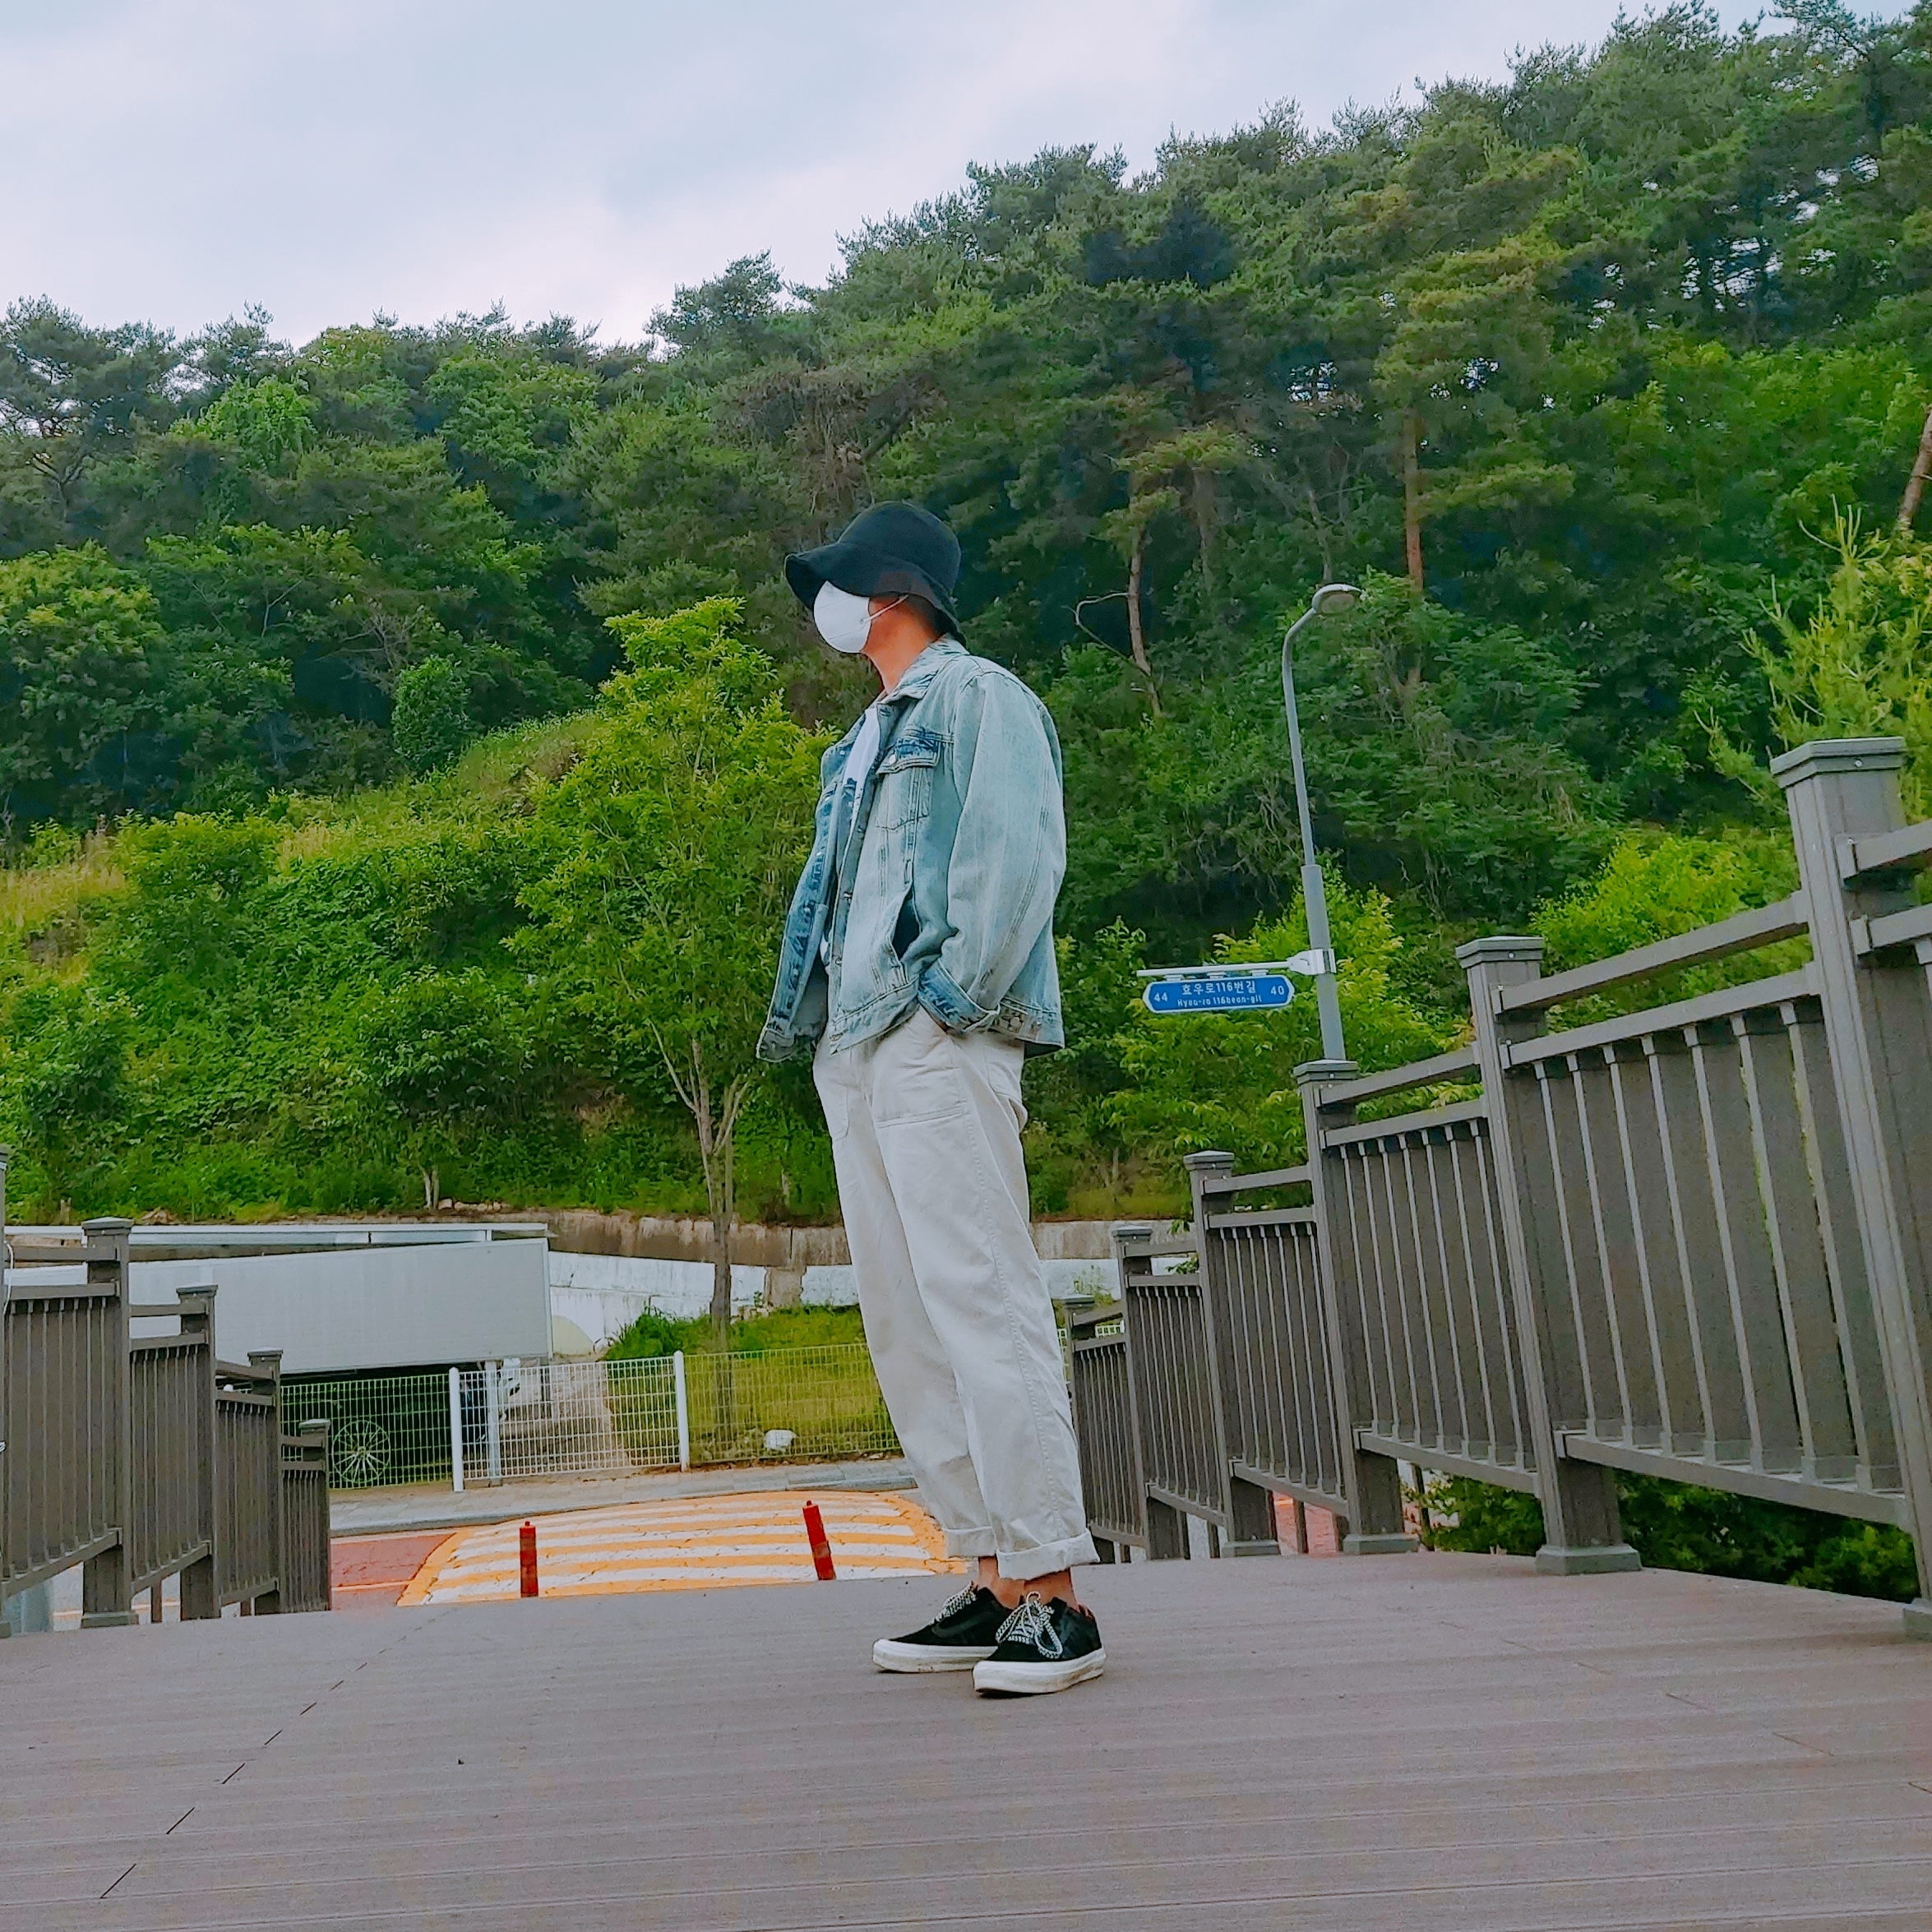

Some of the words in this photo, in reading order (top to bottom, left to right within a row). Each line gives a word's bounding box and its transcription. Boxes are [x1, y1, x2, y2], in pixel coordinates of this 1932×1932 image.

[1181, 980, 1256, 996] 효우로116번길
[1270, 985, 1285, 996] 40
[1153, 991, 1168, 1002] 44
[1213, 995, 1262, 1005] 116beon-gil
